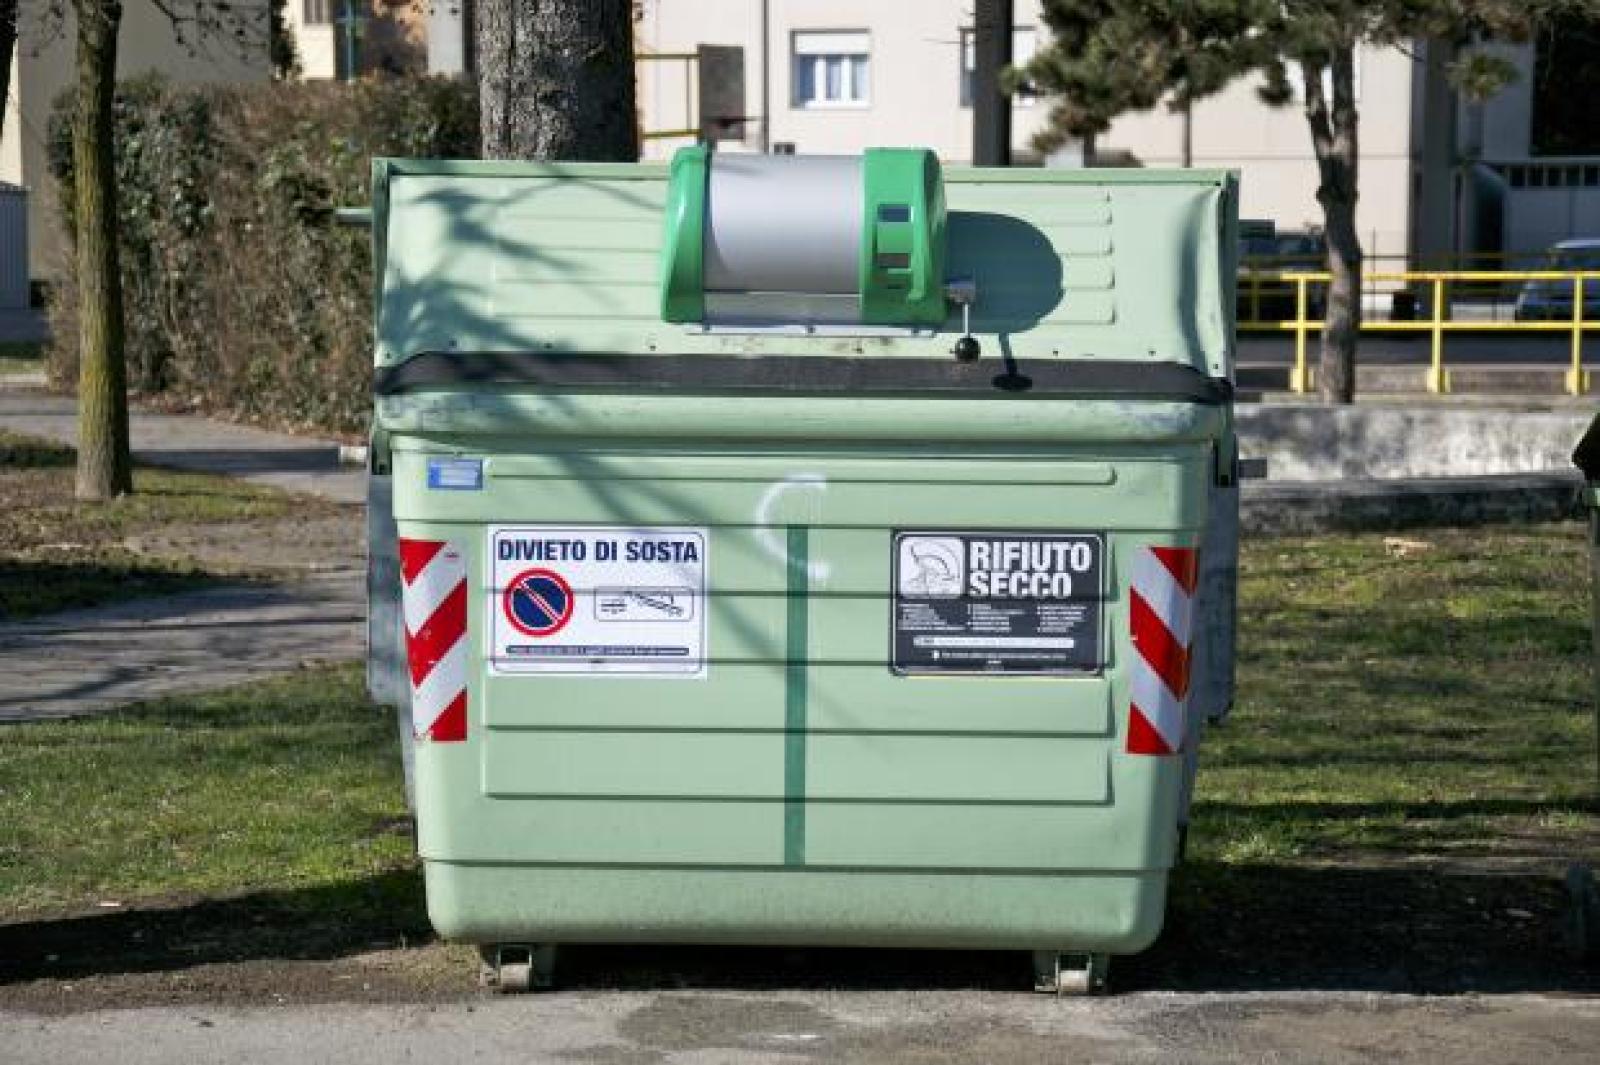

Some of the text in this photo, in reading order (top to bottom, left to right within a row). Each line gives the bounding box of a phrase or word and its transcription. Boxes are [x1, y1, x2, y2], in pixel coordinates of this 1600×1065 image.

[498, 539, 699, 562] DIVIETO DI SOSTA
[970, 541, 1092, 571] RIFIUTO
[970, 572, 1072, 598] SECCO
